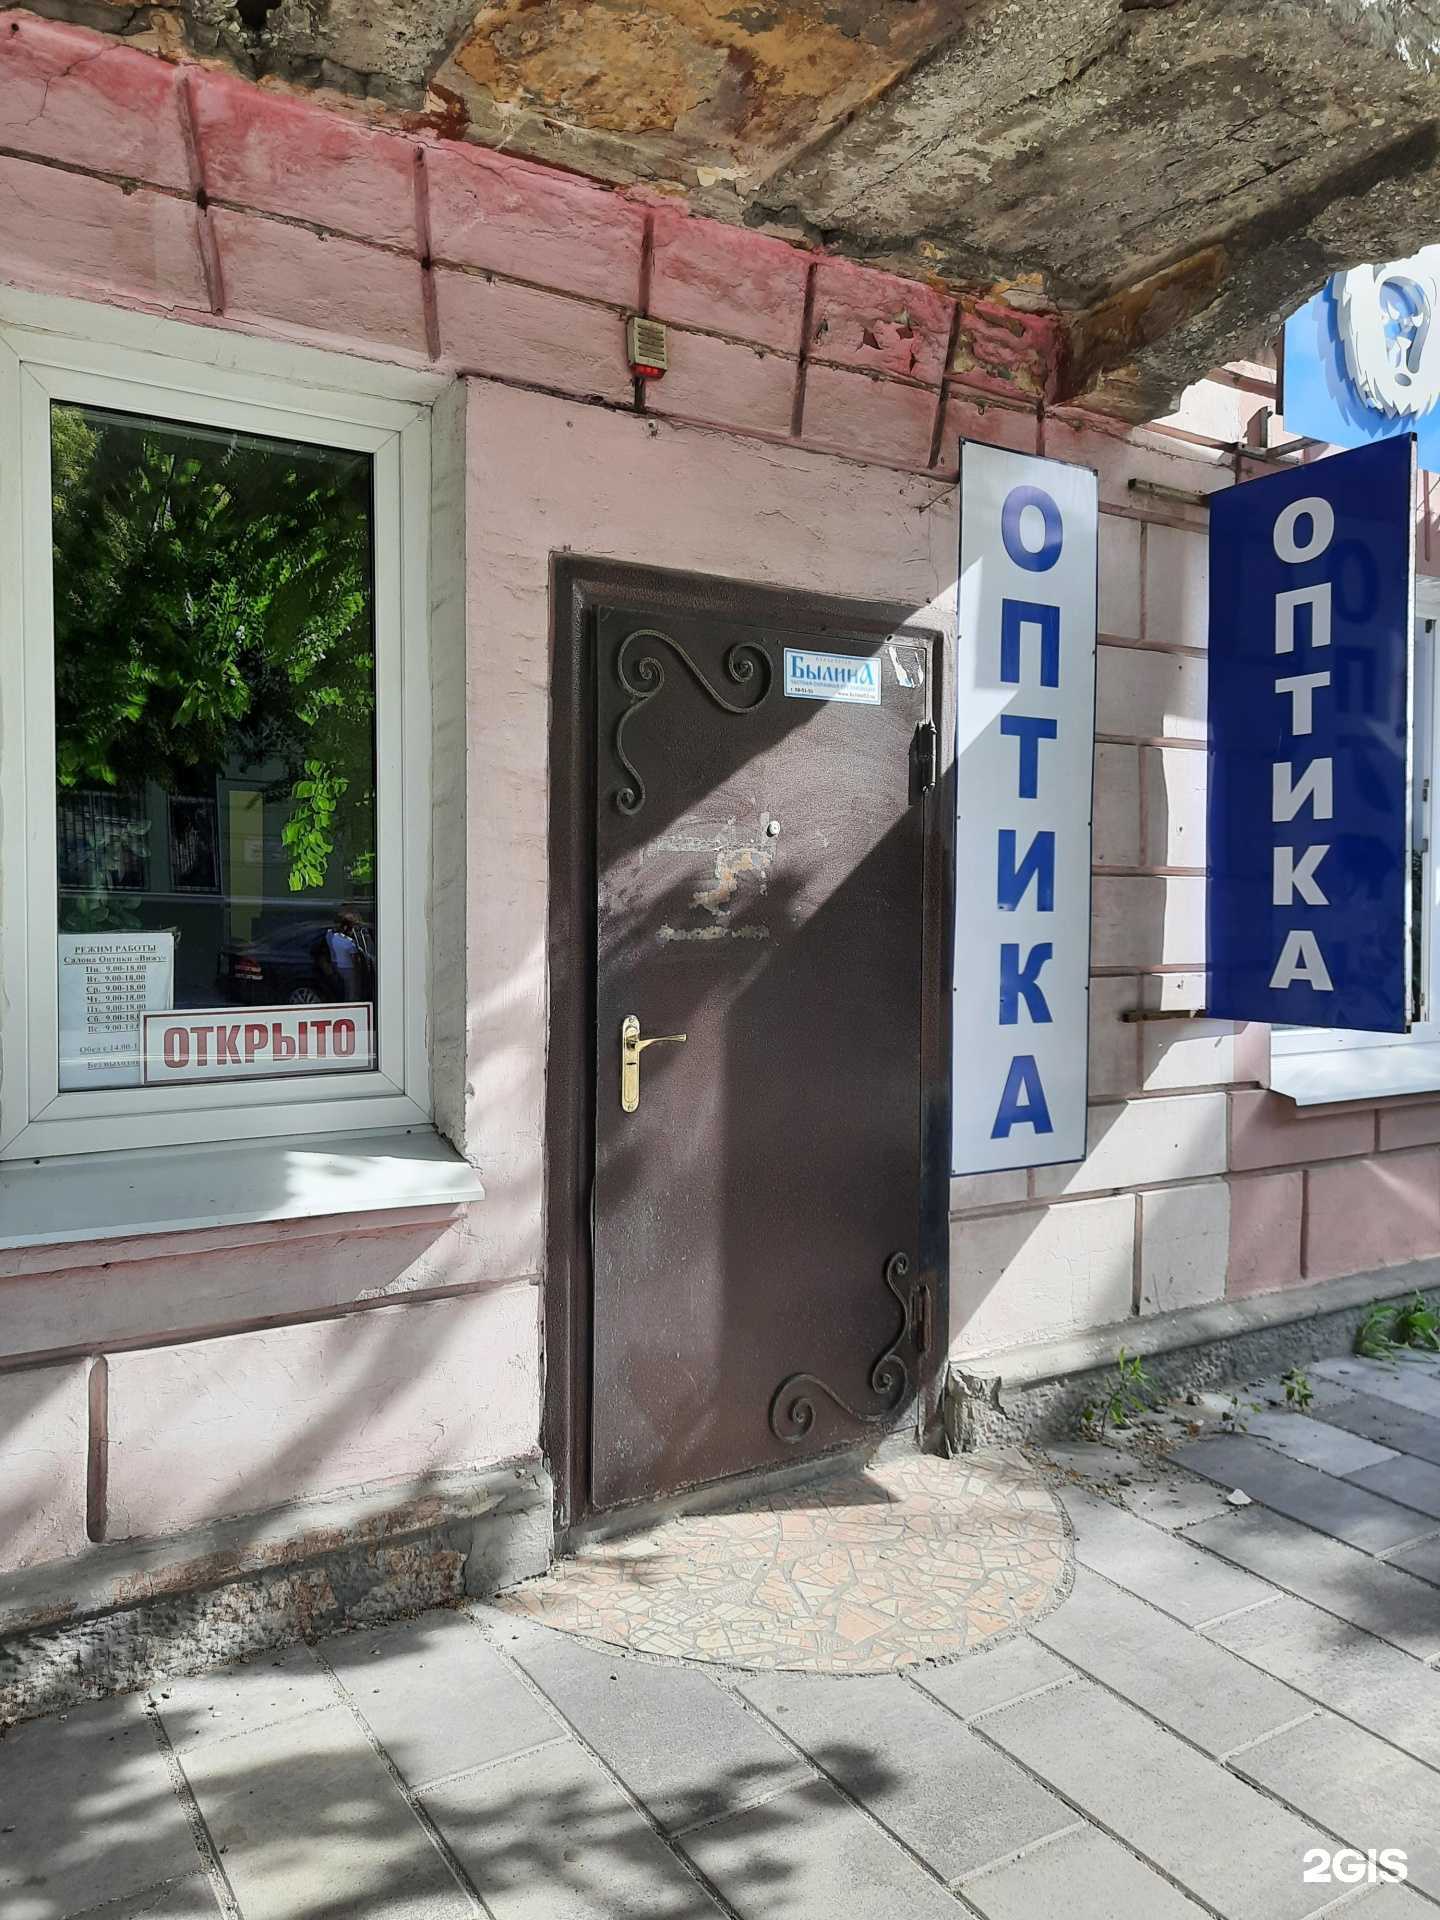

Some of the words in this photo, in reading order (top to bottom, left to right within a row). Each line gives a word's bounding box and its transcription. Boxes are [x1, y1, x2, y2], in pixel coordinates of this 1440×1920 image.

[1270, 496, 1335, 992] ОПТИКА
[991, 485, 1062, 1139] ОПТИКА
[75, 945, 112, 953] РЕЖИМ
[116, 944, 156, 953] РАБОТЫ
[99, 956, 132, 964] Оптики
[164, 1018, 355, 1068] ОТКРЫТО
